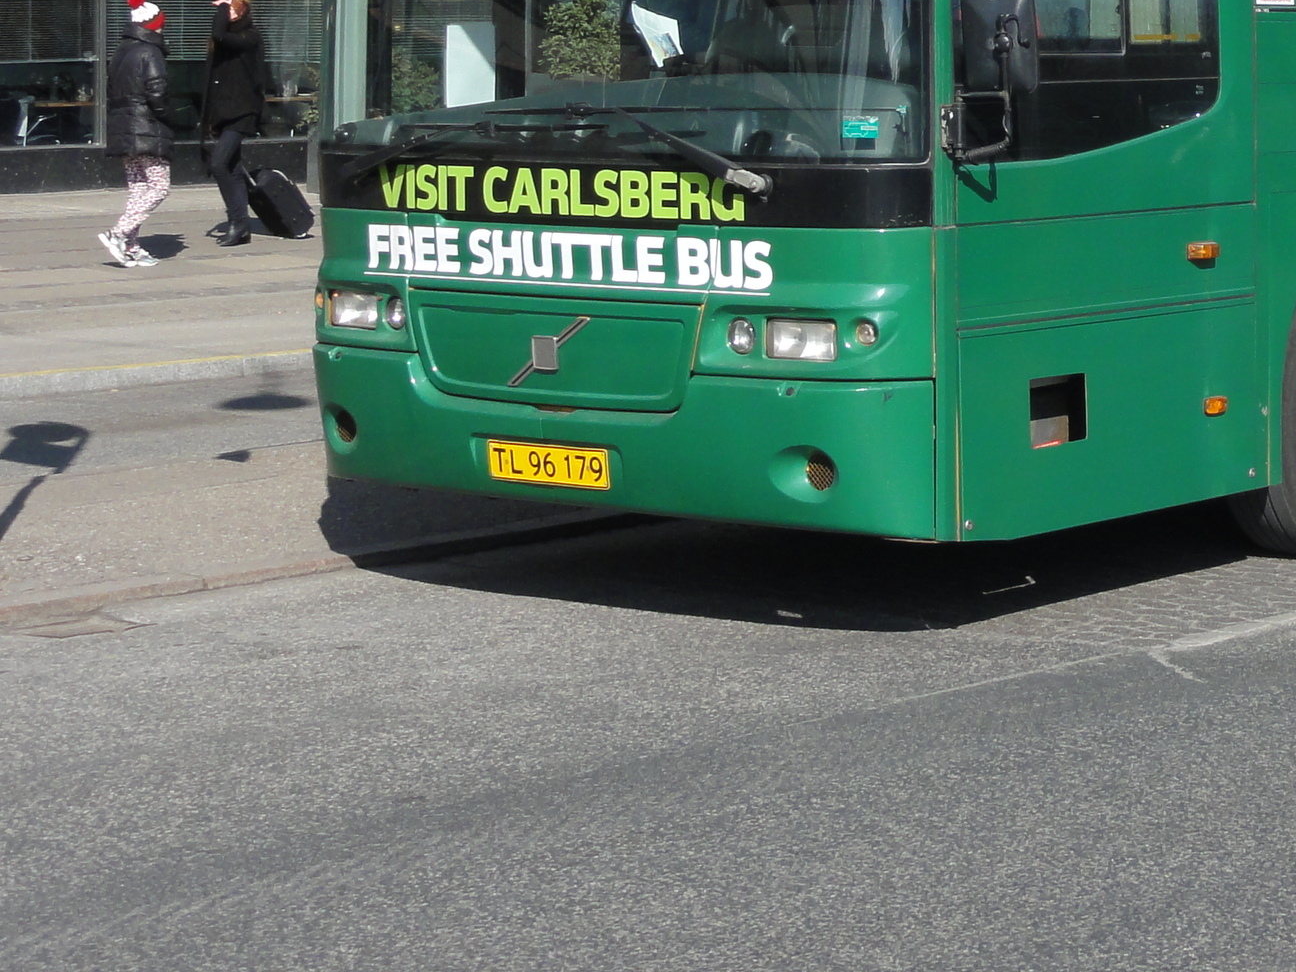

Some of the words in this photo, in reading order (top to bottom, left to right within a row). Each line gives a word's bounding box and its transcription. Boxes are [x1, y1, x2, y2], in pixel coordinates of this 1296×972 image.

[379, 164, 474, 211] VISIT
[483, 166, 745, 221] CARLSBERG
[368, 224, 460, 273] FREE
[469, 229, 666, 285] SHUTTLE
[677, 236, 773, 290] BUS
[493, 448, 523, 474] TL
[528, 451, 556, 477] 96
[564, 454, 602, 482] 179
